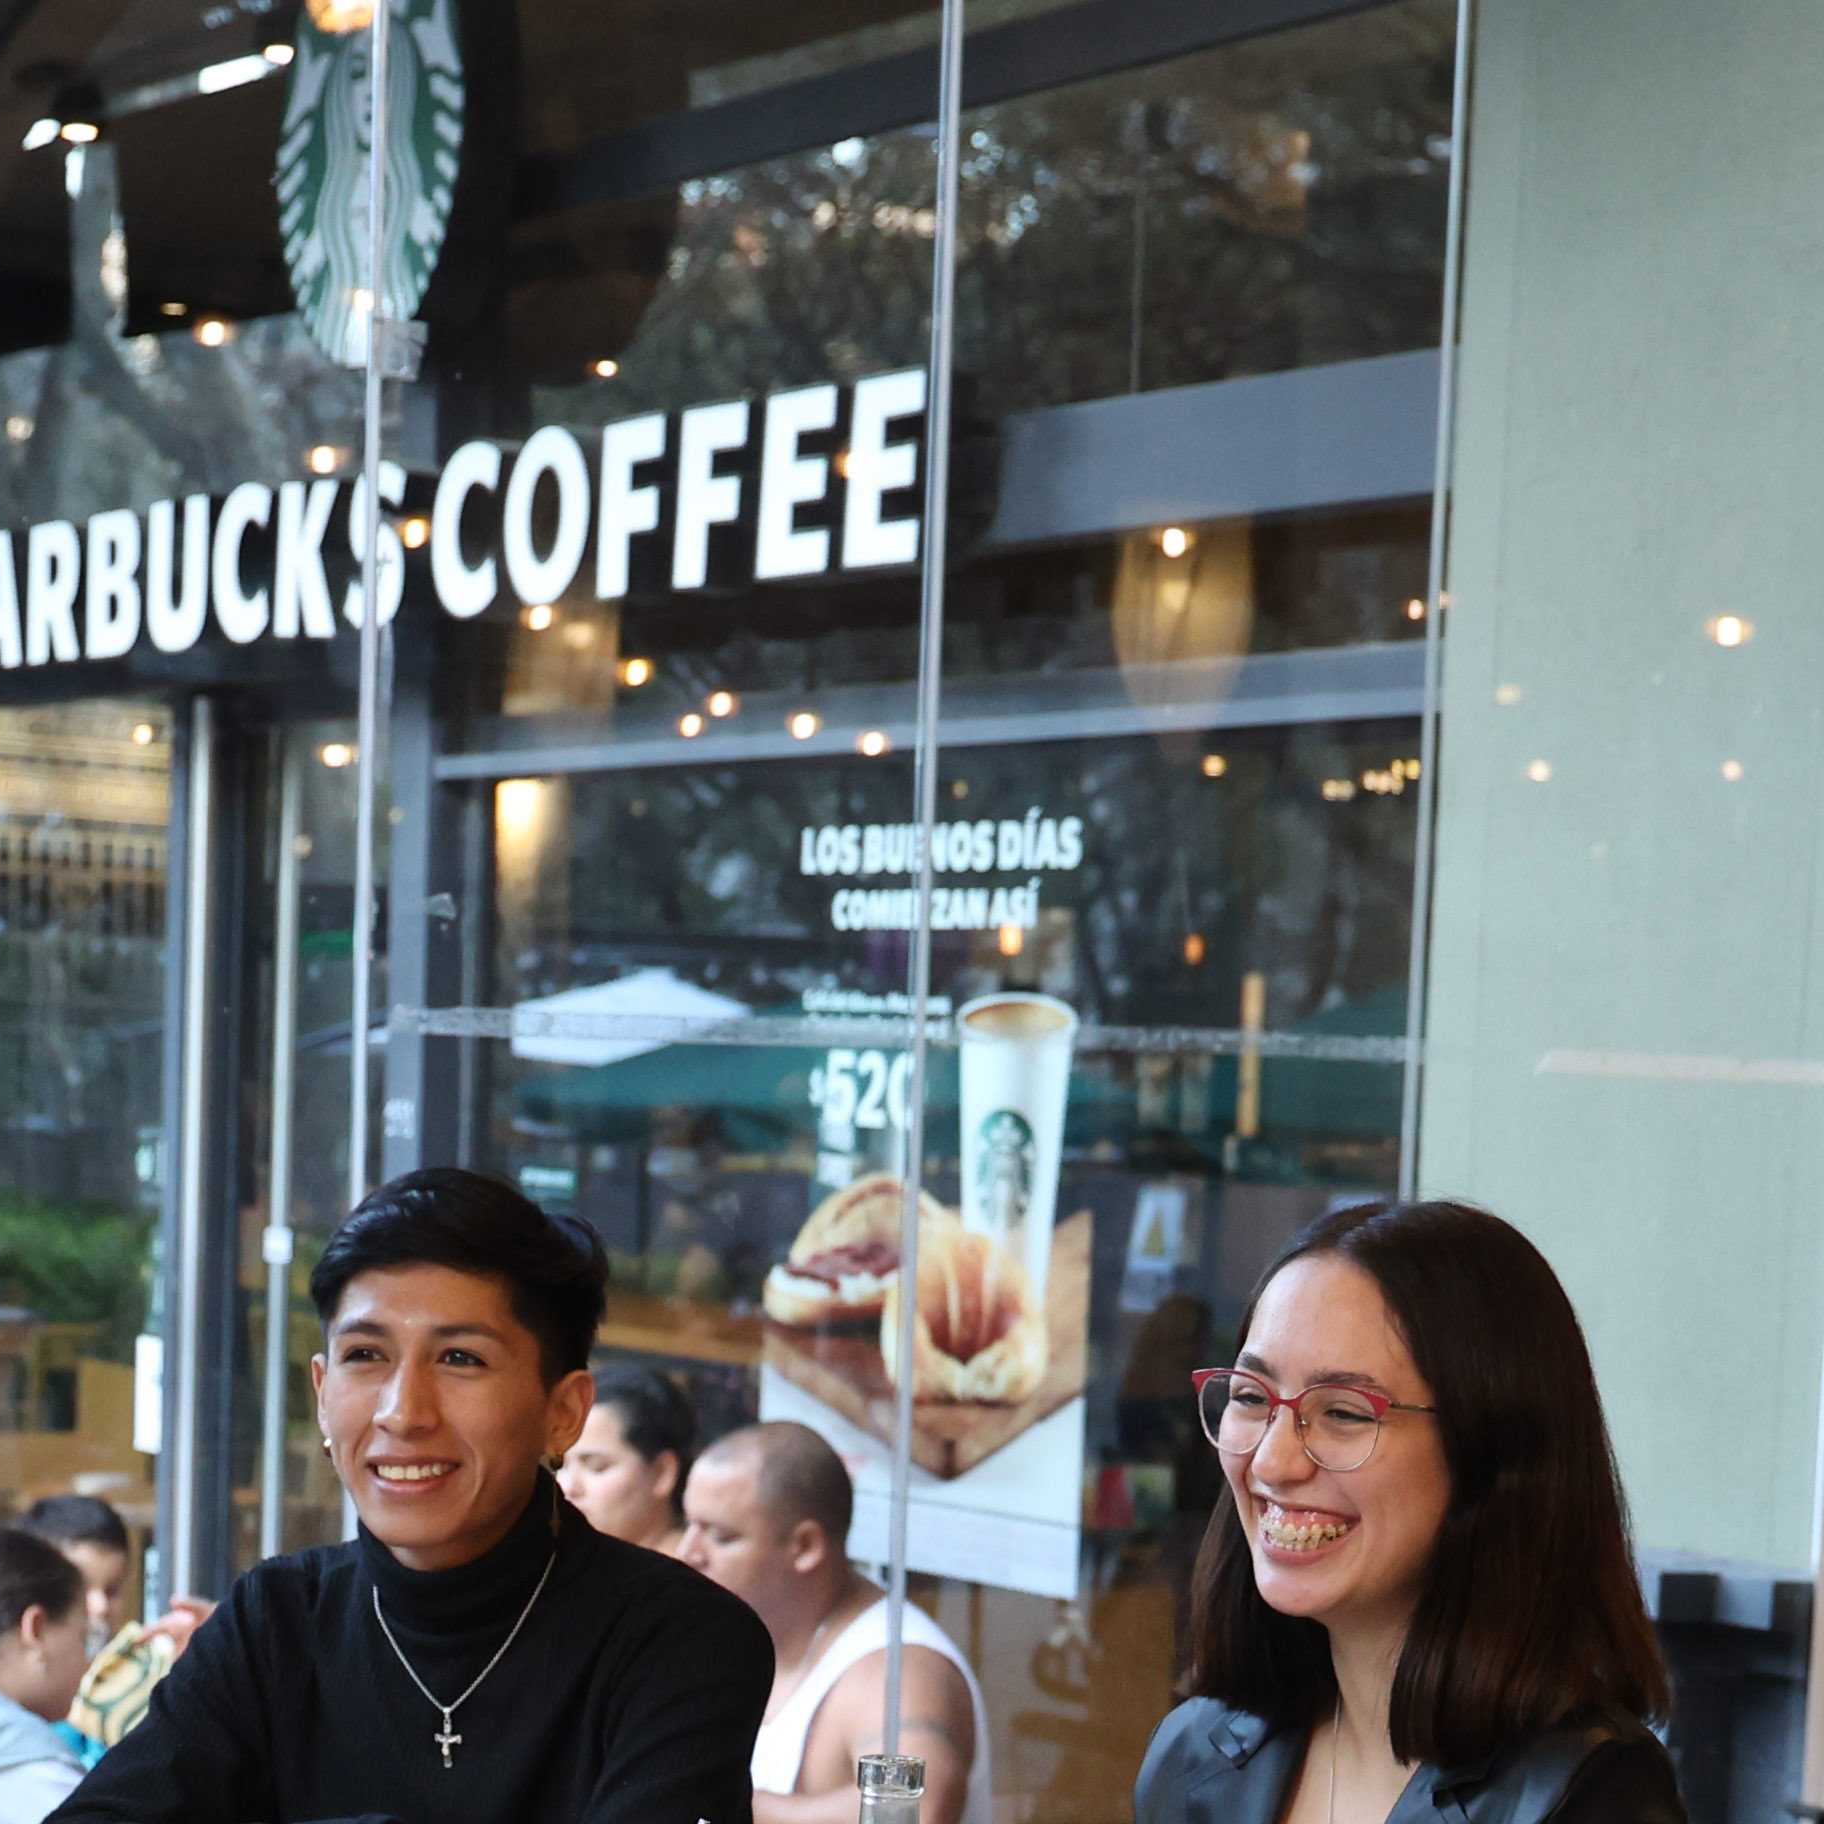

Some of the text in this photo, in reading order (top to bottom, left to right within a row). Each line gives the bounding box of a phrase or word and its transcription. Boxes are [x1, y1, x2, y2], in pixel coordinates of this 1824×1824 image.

[431, 367, 927, 620] COFFEE
[799, 824, 861, 876] LOS
[997, 805, 1084, 871] DÍAS
[831, 886, 989, 931] COMIEZAN
